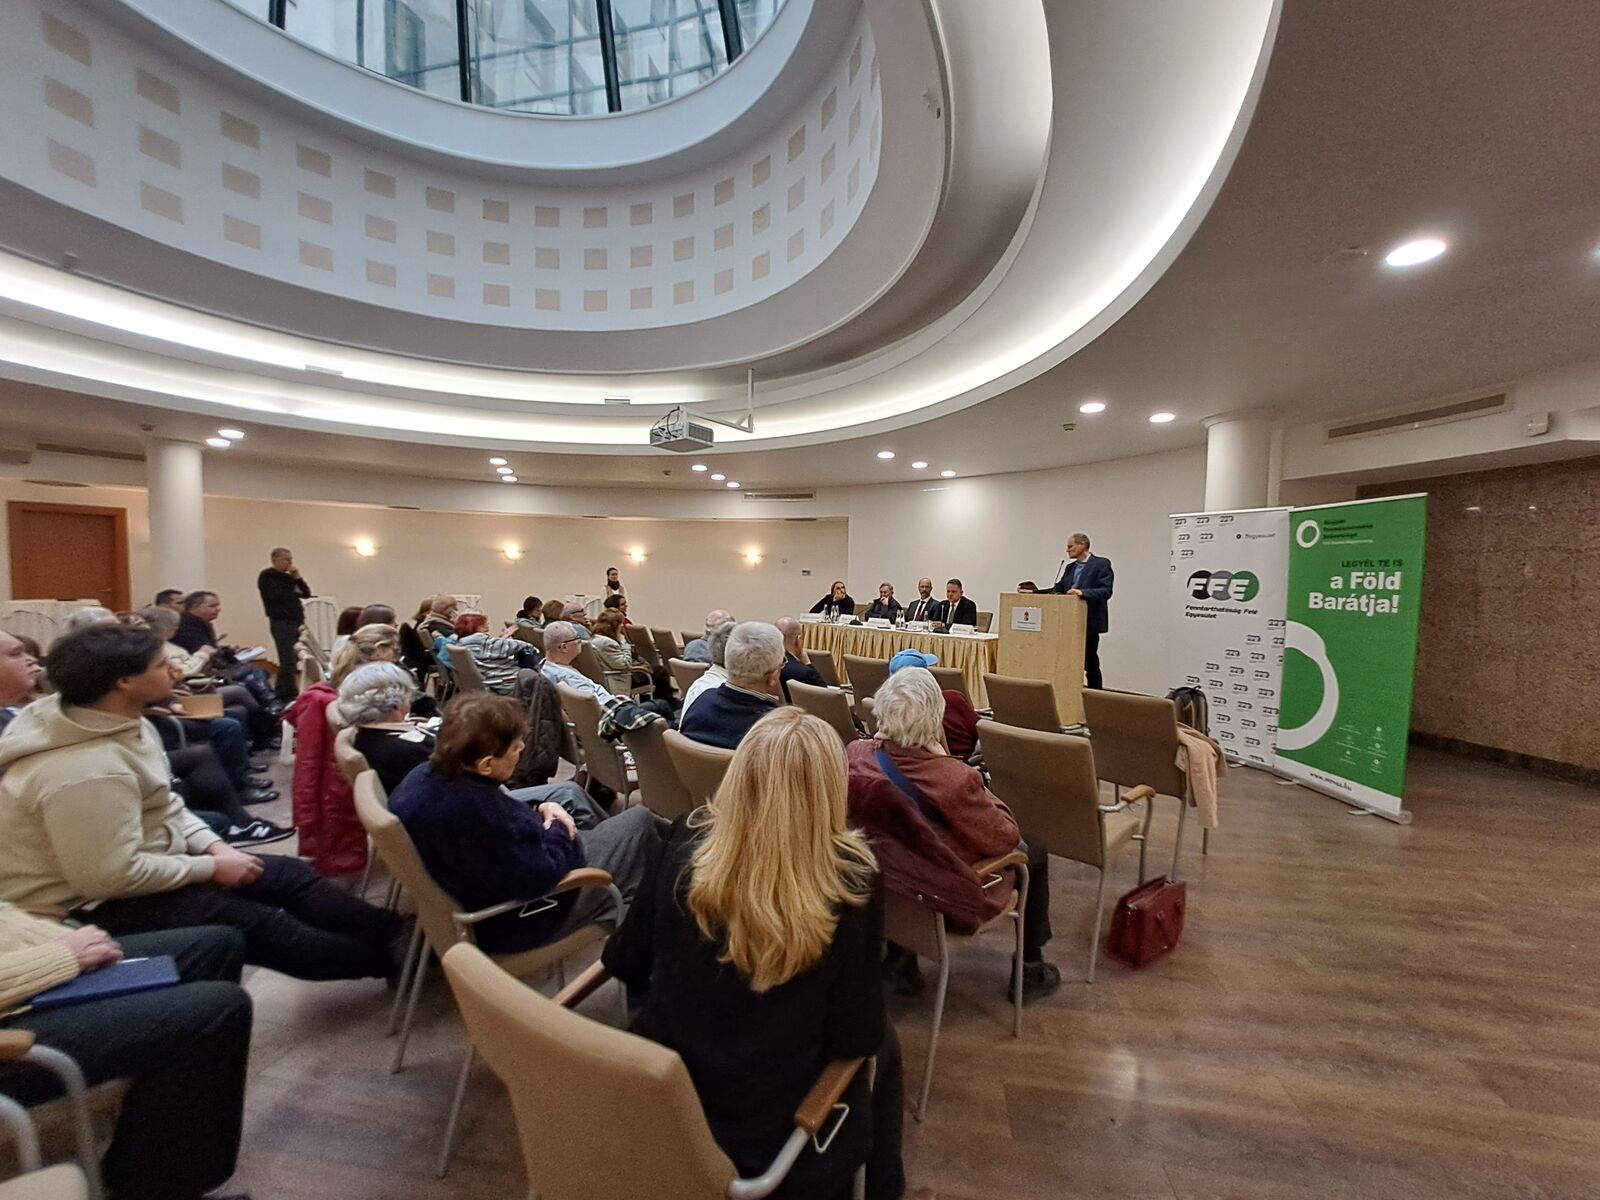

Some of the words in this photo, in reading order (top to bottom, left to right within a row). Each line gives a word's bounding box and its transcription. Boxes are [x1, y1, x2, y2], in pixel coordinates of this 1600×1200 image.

[1341, 559, 1375, 568] LEGYÉL
[1378, 559, 1390, 568] TE
[1392, 559, 1404, 567] IS
[1187, 576, 1251, 601] FFE
[1329, 575, 1344, 589] a
[1350, 571, 1402, 590] Föld
[1308, 592, 1400, 617] Barátja!
